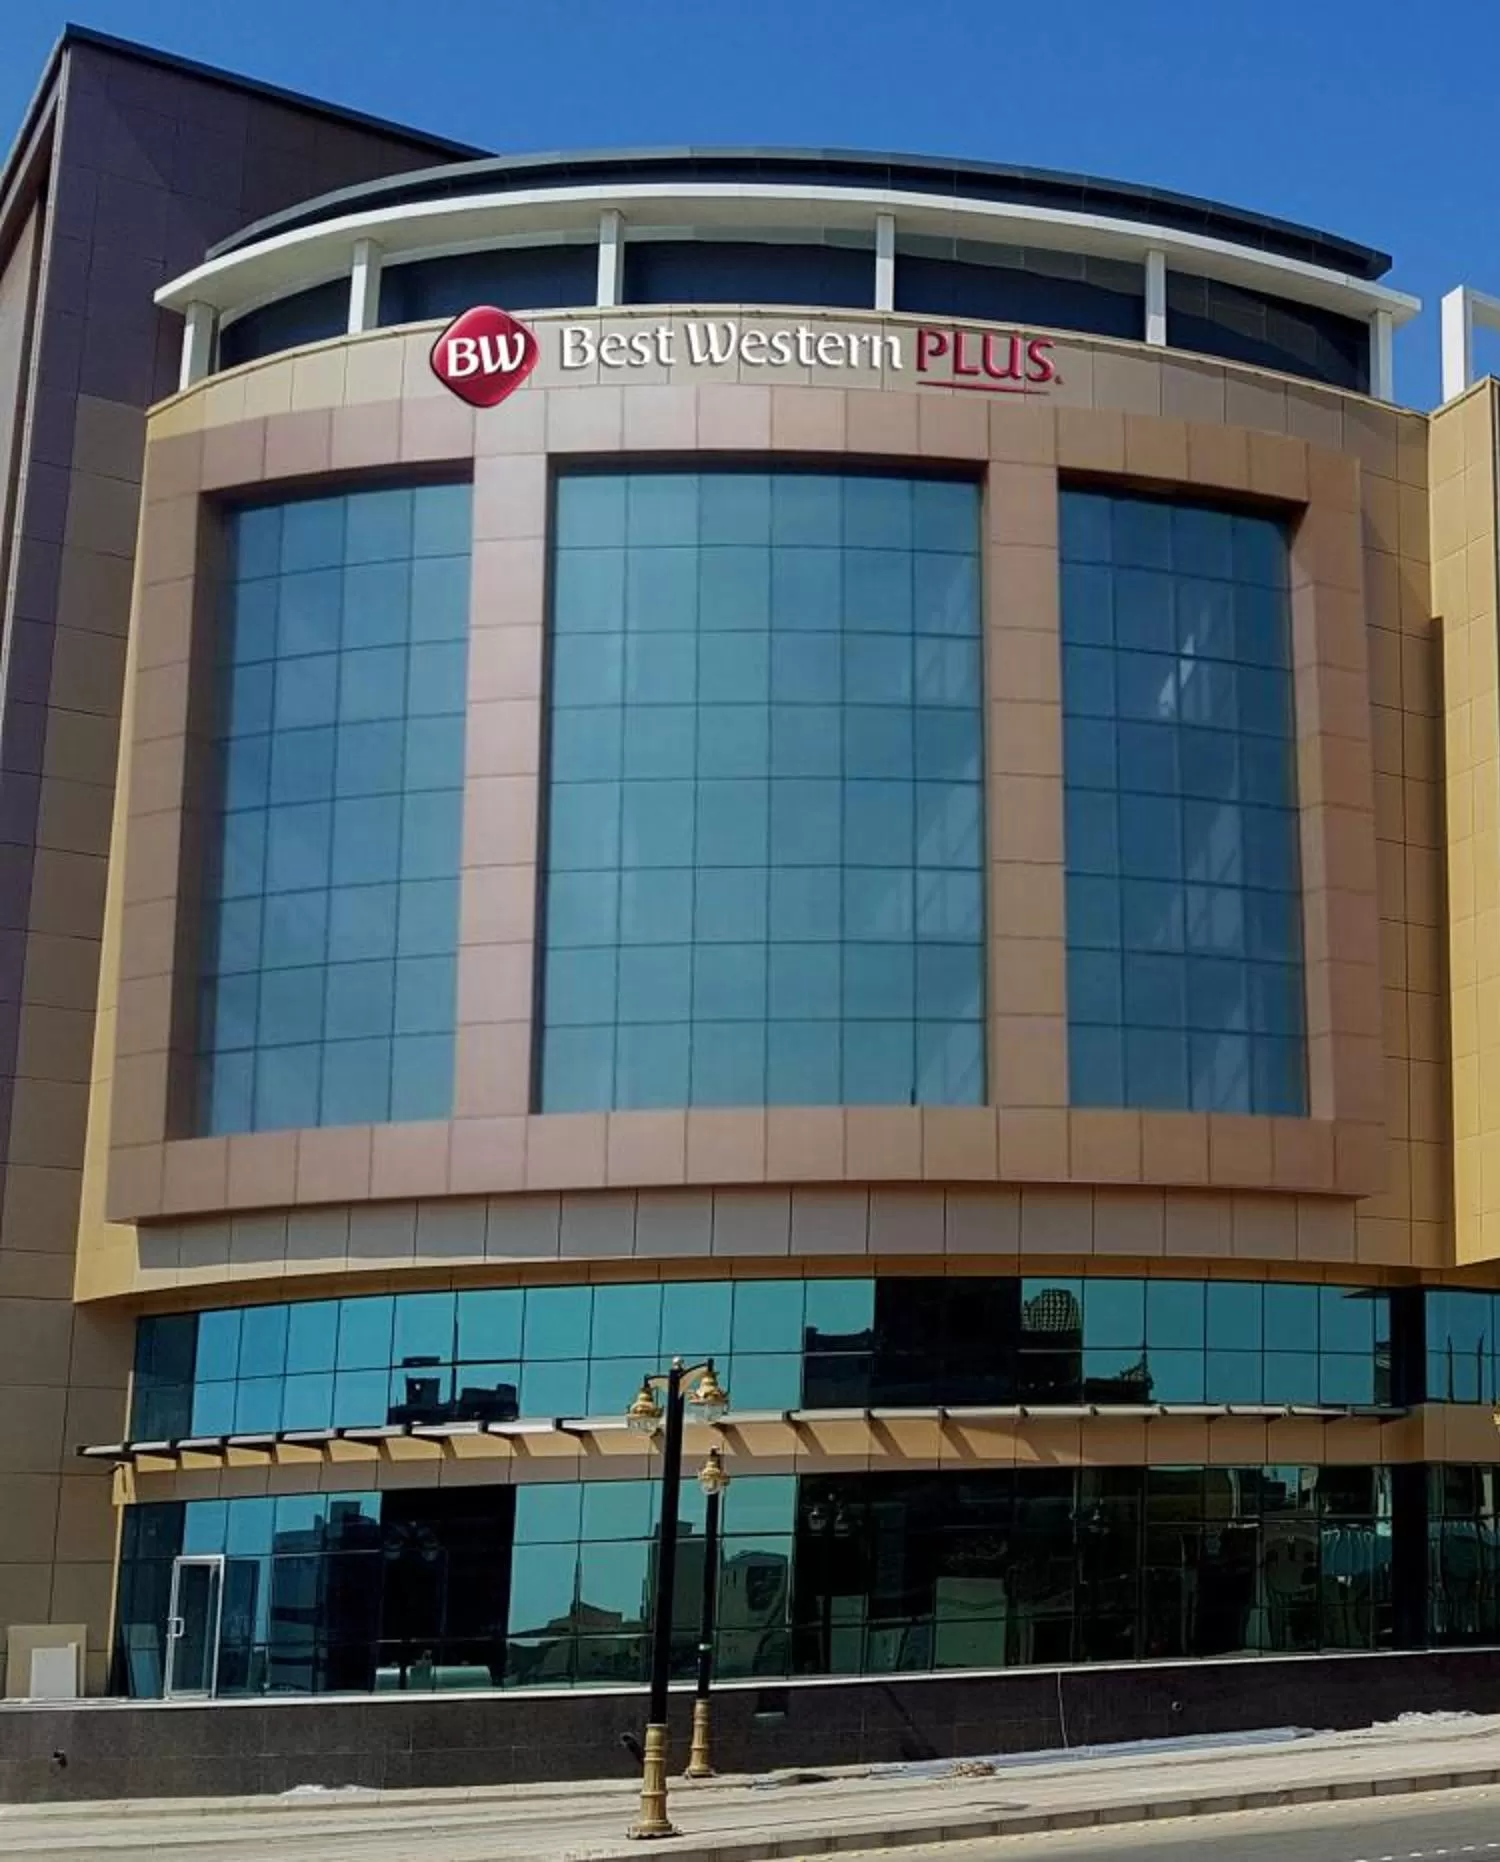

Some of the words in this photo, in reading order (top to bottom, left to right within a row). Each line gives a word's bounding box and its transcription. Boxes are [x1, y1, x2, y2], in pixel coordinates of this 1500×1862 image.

[447, 332, 525, 377] BW
[561, 325, 676, 368] Best
[685, 321, 903, 369] Western
